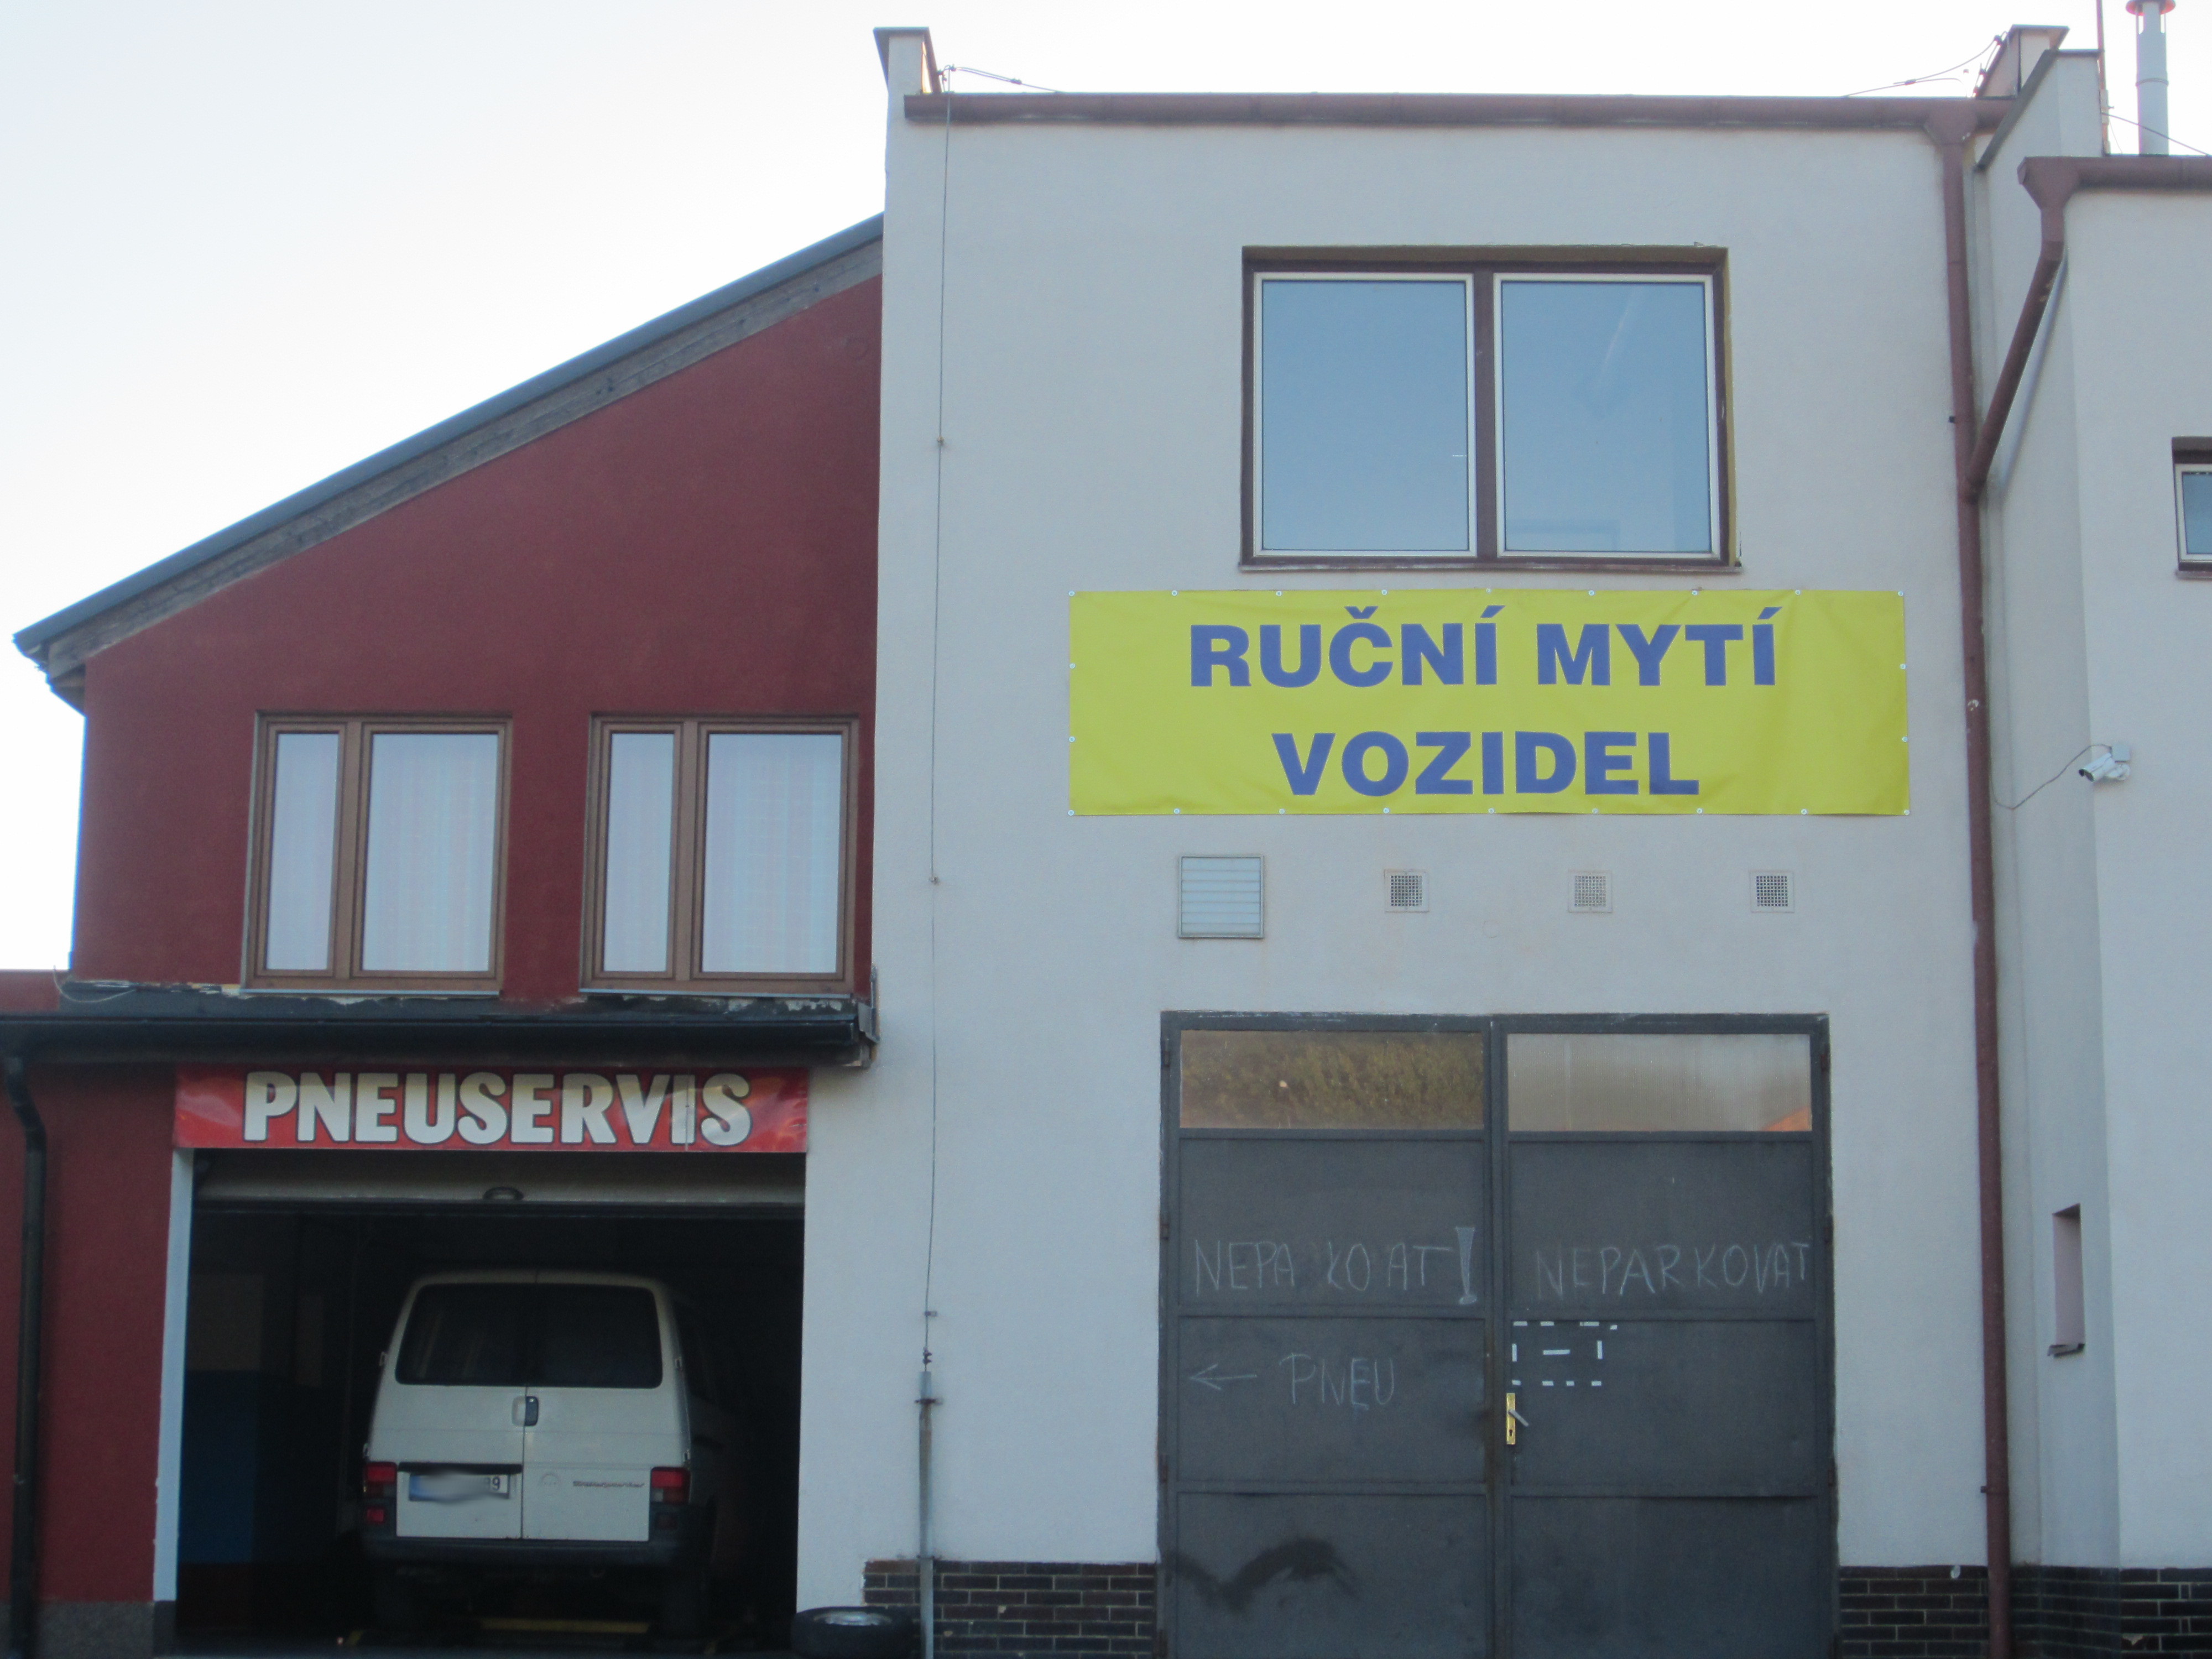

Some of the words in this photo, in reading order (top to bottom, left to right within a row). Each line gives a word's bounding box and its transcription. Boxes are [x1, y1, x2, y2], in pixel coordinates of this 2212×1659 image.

[1189, 605, 1505, 687] RUČNÍ
[1536, 607, 1783, 687] MYTÍ
[1271, 731, 1700, 797] VOZIDEL
[242, 1071, 753, 1146] PNEUSERVIS
[1535, 1241, 1811, 1301] NEPARKOVAT
[1279, 1352, 1396, 1411] PNEU
